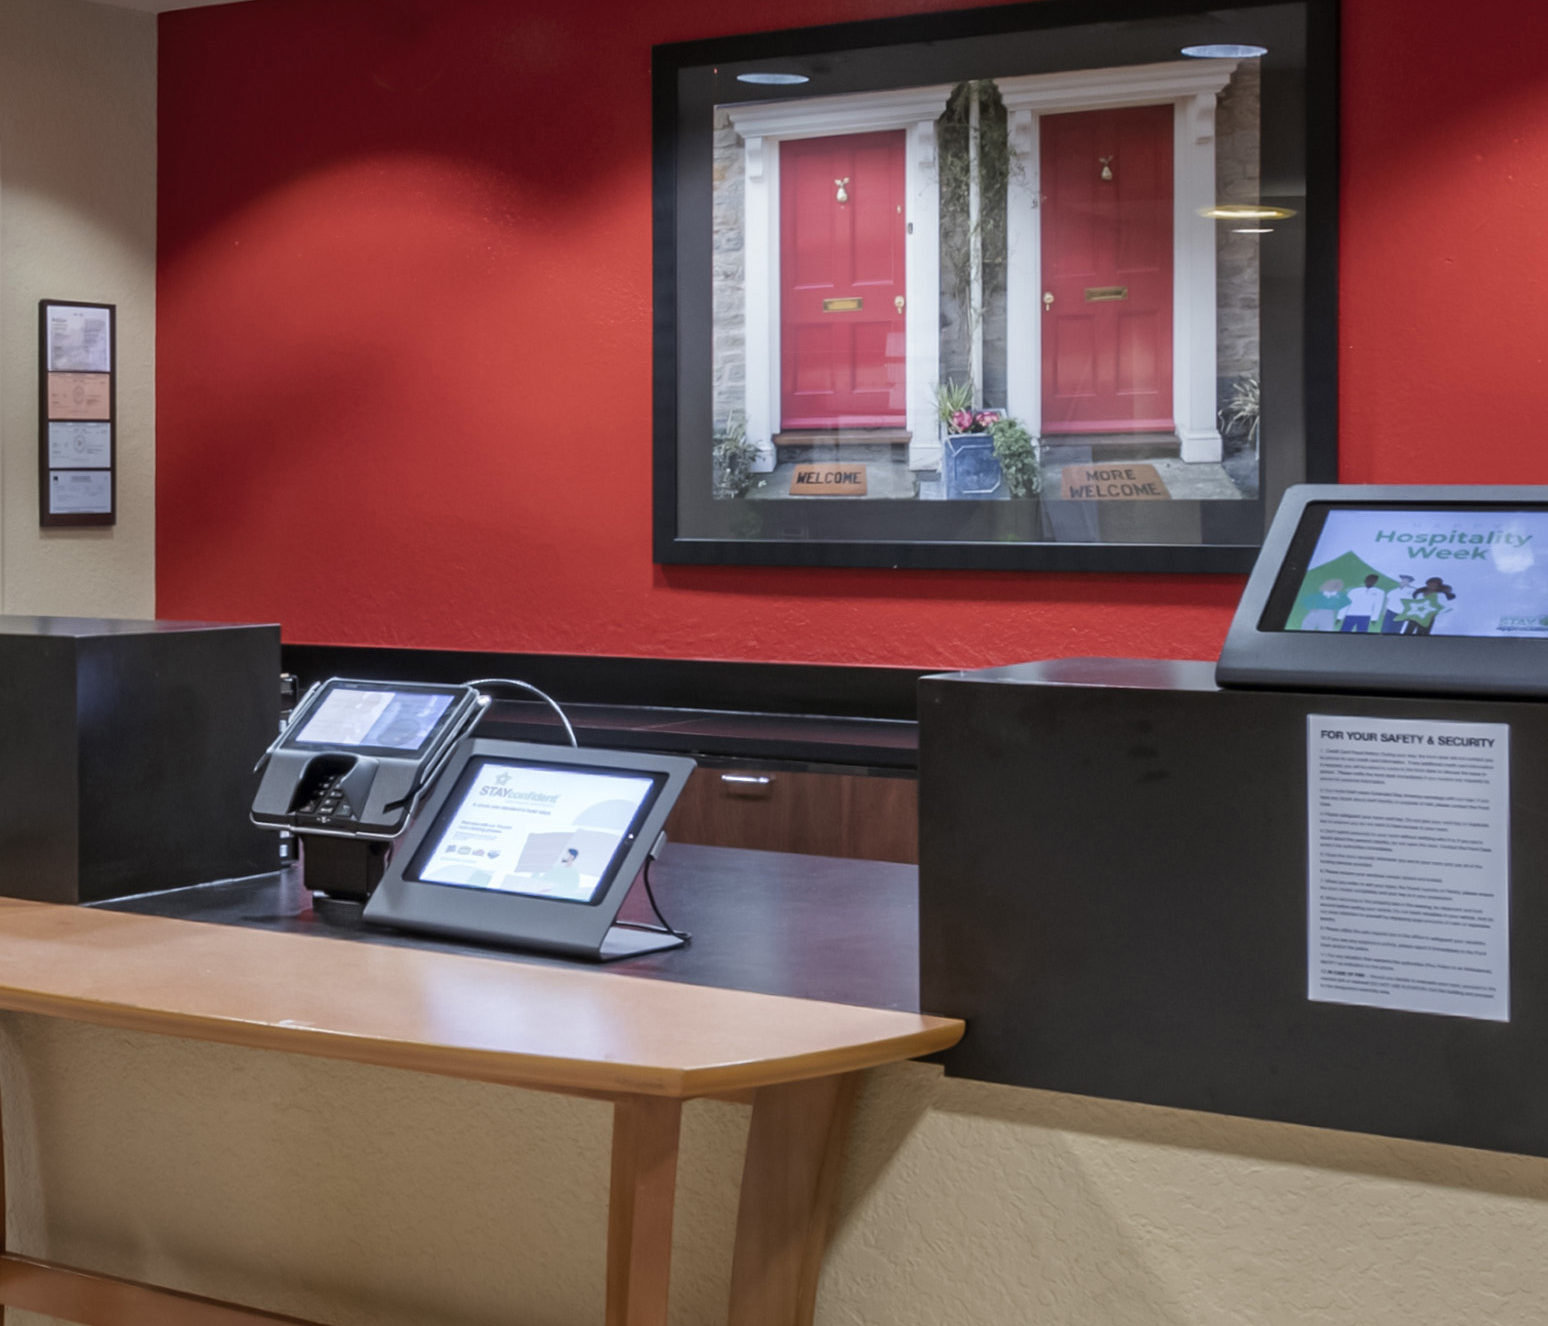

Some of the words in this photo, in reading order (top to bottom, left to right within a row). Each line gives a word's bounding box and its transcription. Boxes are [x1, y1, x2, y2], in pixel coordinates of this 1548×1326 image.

[796, 472, 862, 484] WELCOME
[1085, 469, 1137, 482] MORE
[1069, 483, 1161, 498] WELCOME
[1375, 530, 1533, 548] Hospitality
[1407, 546, 1489, 560] Week
[1320, 730, 1344, 739] FOR
[1346, 731, 1378, 742] YOUR
[1380, 733, 1424, 744] SAFETY
[1427, 735, 1435, 745] &
[1437, 736, 1496, 748] SECURITY
